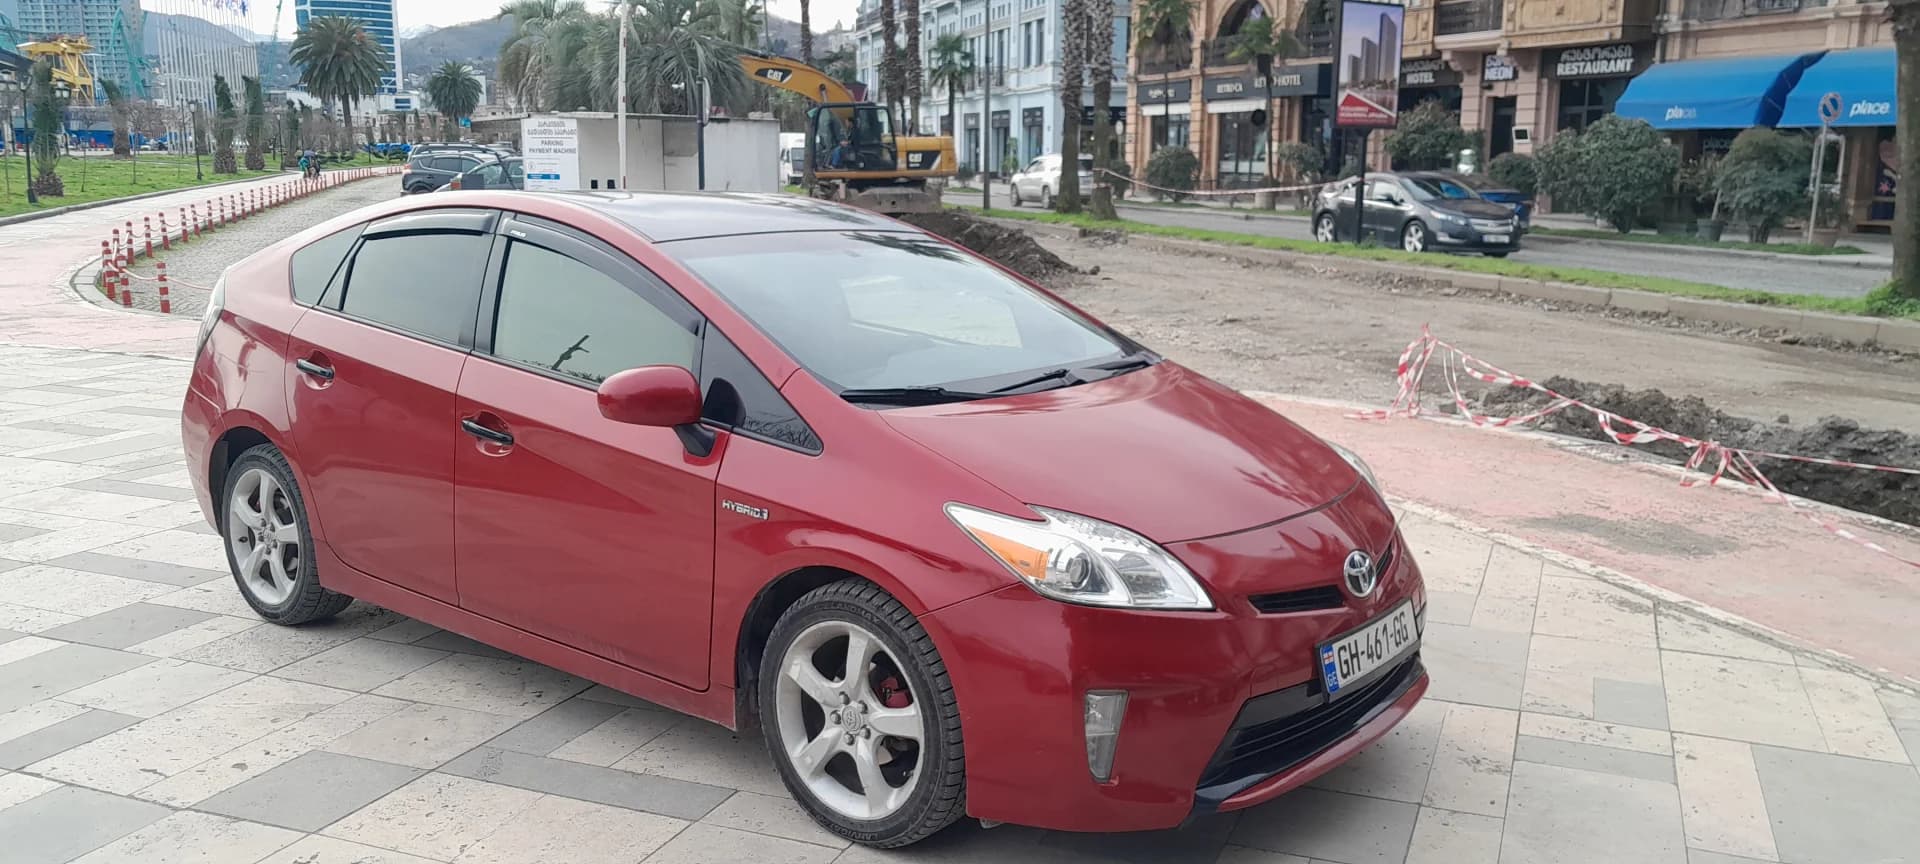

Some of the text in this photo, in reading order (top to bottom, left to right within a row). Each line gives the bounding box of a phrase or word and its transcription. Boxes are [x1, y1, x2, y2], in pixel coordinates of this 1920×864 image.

[767, 69, 783, 81] CAT
[1556, 58, 1634, 76] RESTAURANT
[1406, 71, 1435, 84] HOTEL
[1848, 99, 1891, 118] place
[722, 499, 761, 518] HYBRID
[1337, 611, 1409, 679] GH-461-GG
[1327, 670, 1338, 687] GE
